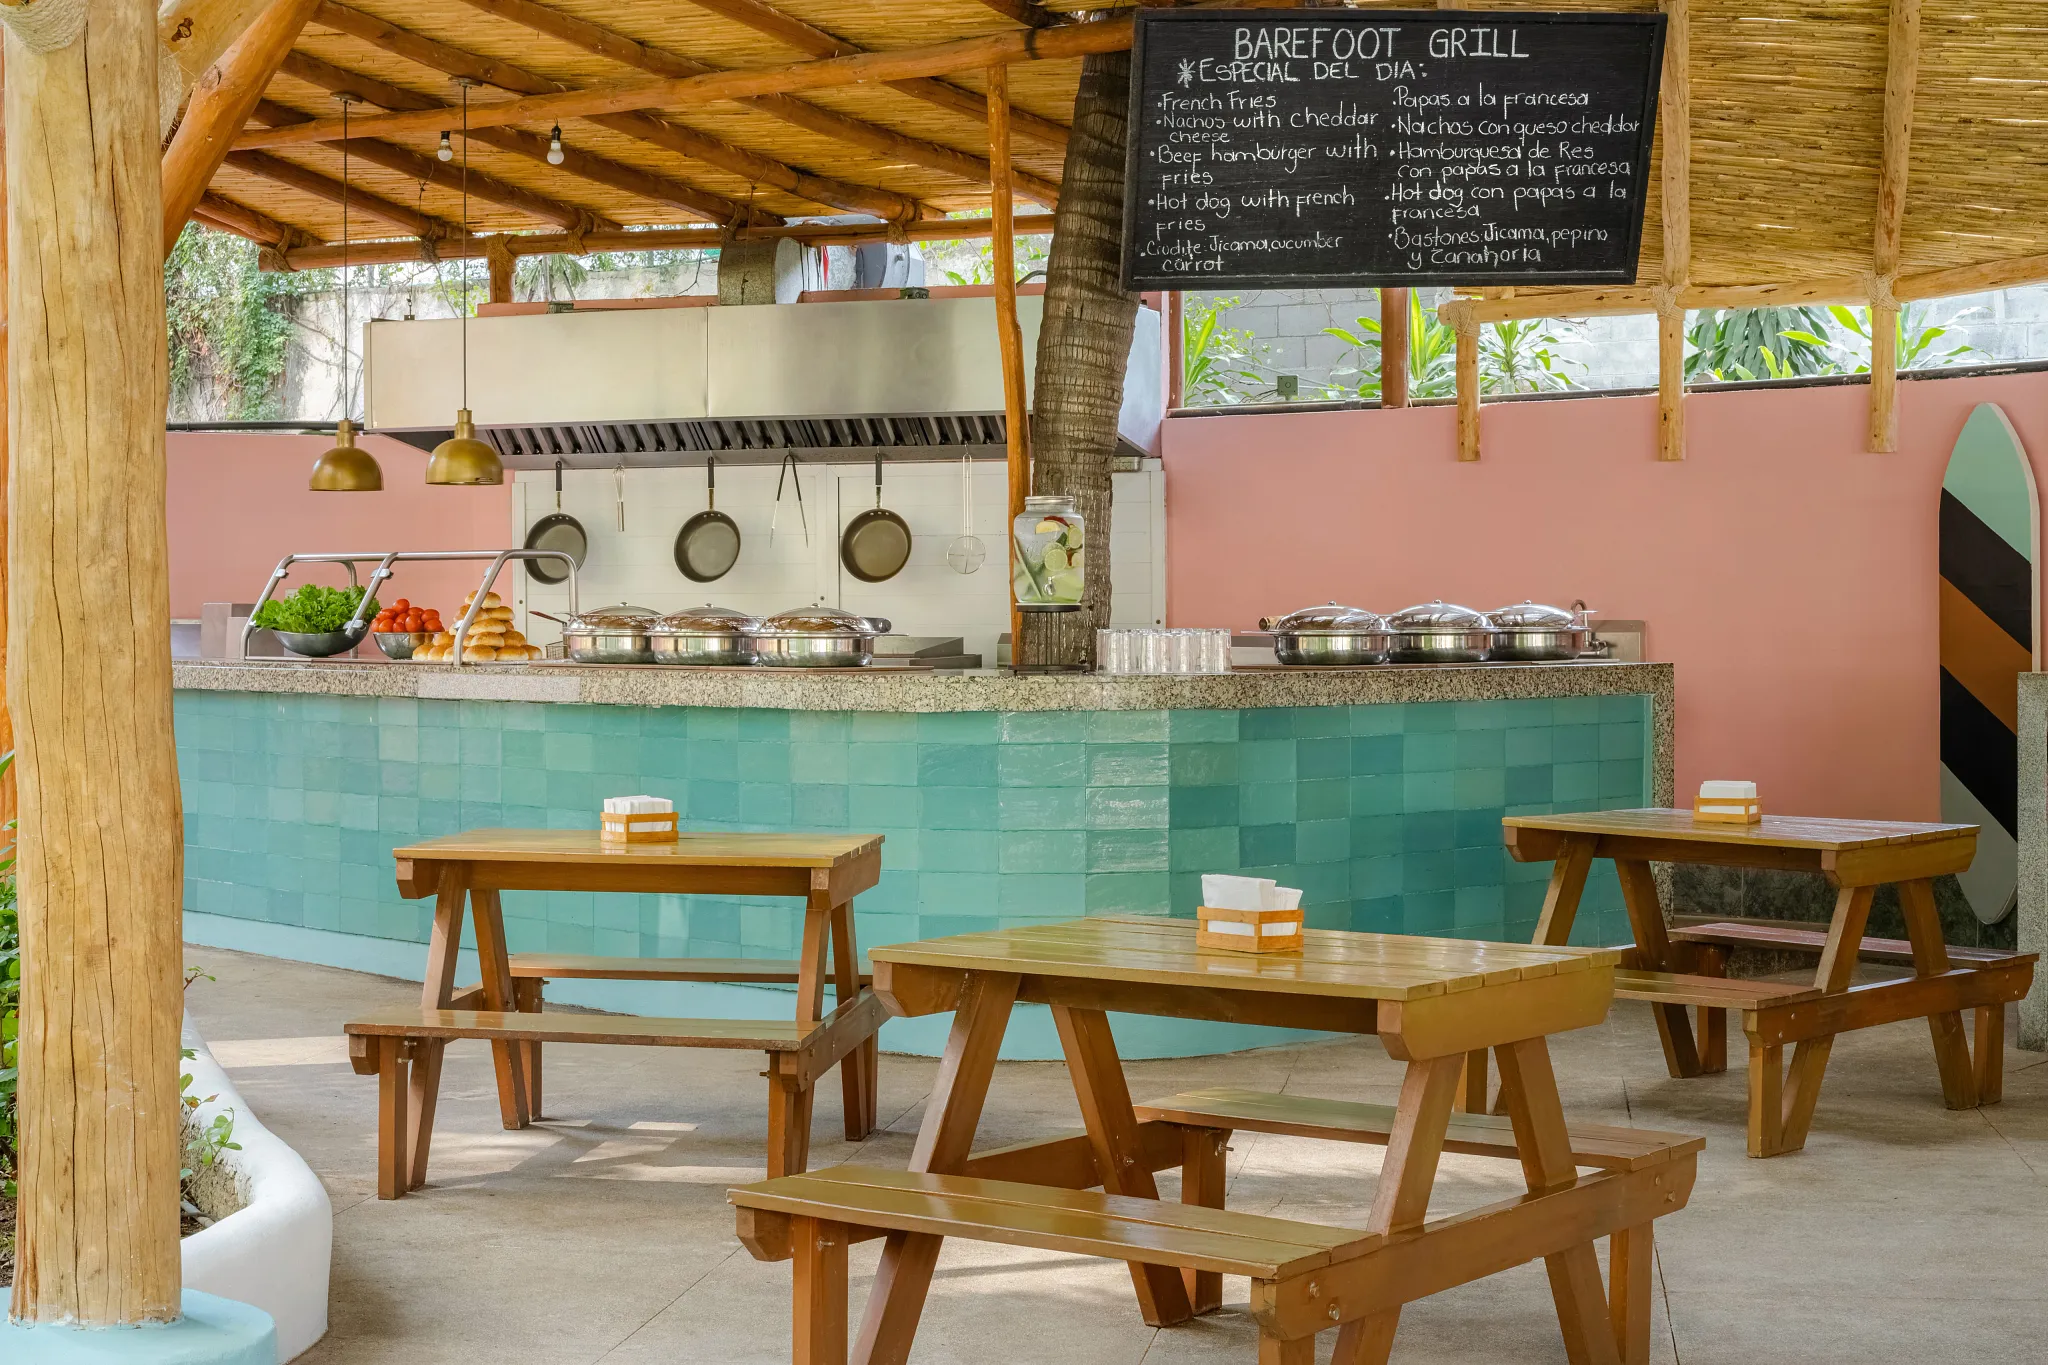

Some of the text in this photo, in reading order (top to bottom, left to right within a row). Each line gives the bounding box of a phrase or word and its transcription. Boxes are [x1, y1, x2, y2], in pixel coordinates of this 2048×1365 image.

[1235, 27, 1530, 60] BAREFOOT GRILL
[1314, 61, 1359, 80] DEL
[1162, 90, 1277, 111] French Fries
[1394, 86, 1450, 115] Papas
[1457, 95, 1470, 106] a
[1479, 82, 1496, 107] la
[1164, 101, 1379, 129] Nachos with cheddar
[1169, 130, 1230, 143] cheese
[1398, 113, 1640, 146] Nachos con queso cheddar
[1211, 143, 1317, 173] hamburger
[1325, 132, 1377, 159] with
[1399, 140, 1594, 166] Hamburguesa de Res
[1442, 163, 1501, 183] papas
[1506, 166, 1519, 177] a
[1528, 161, 1546, 178] la
[1157, 192, 1188, 210] Hot
[1195, 192, 1230, 218] dog
[1241, 189, 1290, 208] with
[1392, 180, 1627, 211] Hot dog con papas a la
[1162, 254, 1225, 272] carrot
[1407, 253, 1422, 270] y
